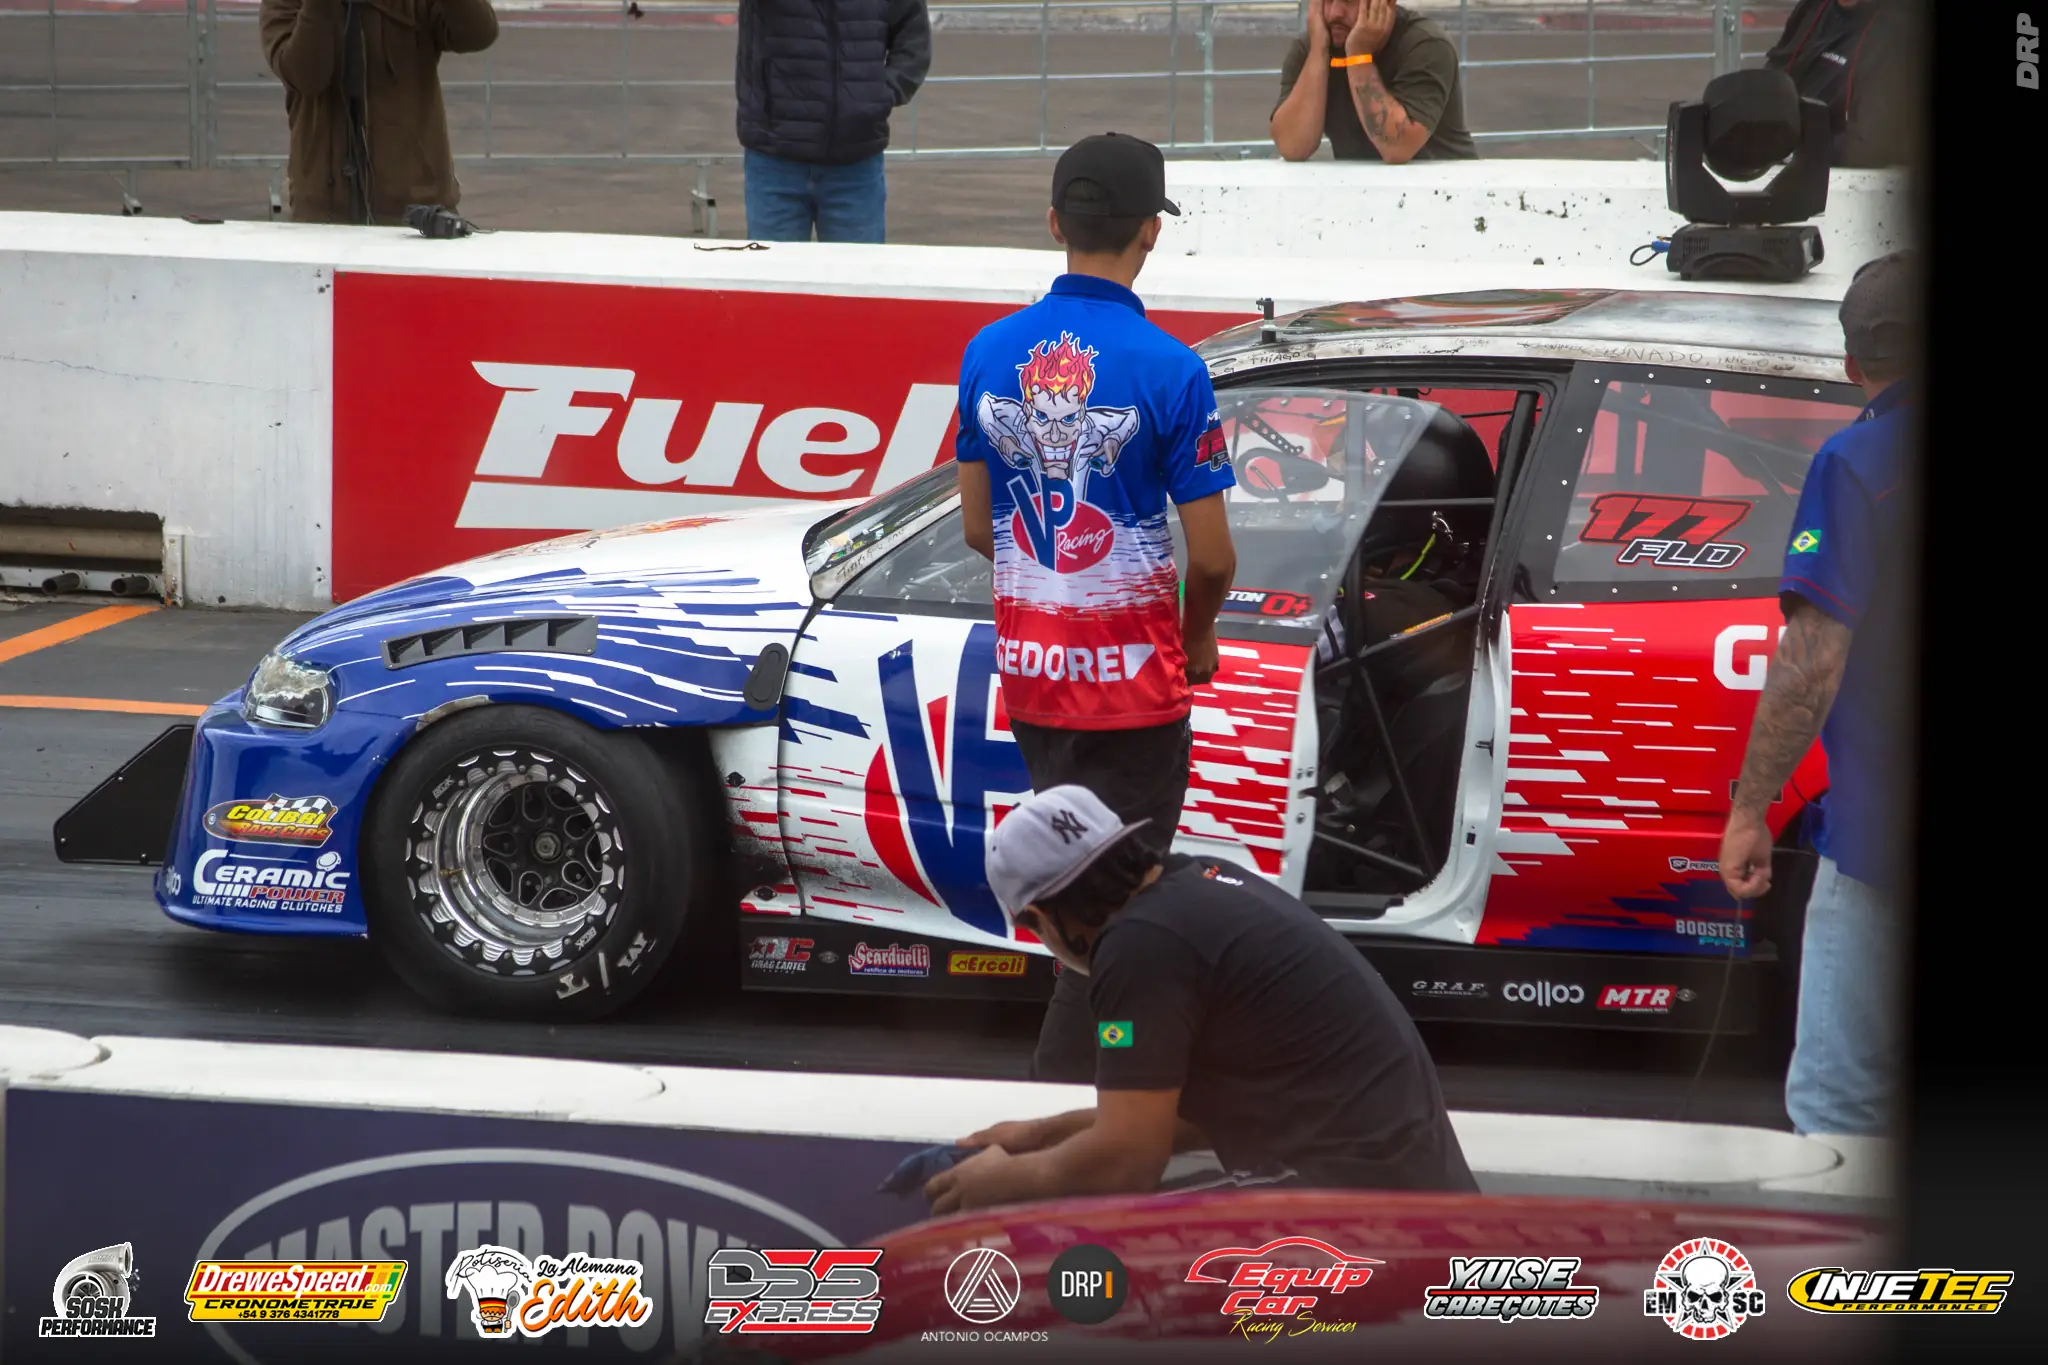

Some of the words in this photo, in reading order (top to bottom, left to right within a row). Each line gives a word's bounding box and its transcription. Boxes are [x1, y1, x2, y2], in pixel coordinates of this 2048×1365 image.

[1007, 474, 1076, 573] VP
[1580, 493, 1751, 545] 177
[227, 805, 327, 825] COLIBRI
[192, 895, 233, 907] ULTIMATE
[234, 898, 277, 910] RACING
[281, 901, 343, 914] CLUTCHES
[249, 885, 345, 904] POWER
[1676, 919, 1745, 939] BOOSTER
[1604, 988, 1671, 1006] MTR
